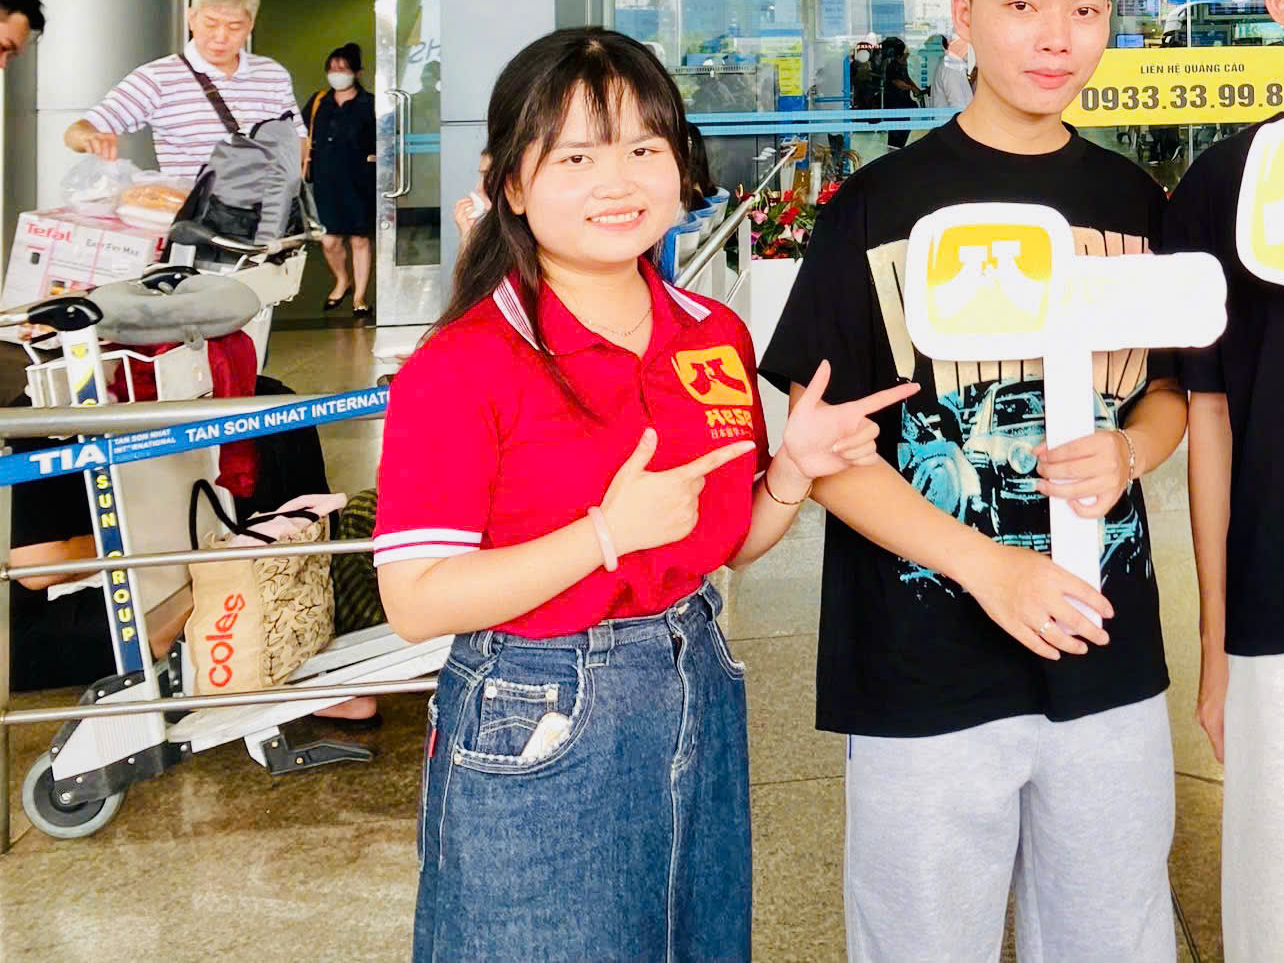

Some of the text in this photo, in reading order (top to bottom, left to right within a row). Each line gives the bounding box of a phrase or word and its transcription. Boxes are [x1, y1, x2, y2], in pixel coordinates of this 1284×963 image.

[26, 222, 72, 243] Tefal
[185, 424, 220, 442] TAN
[224, 417, 260, 436] SON
[264, 407, 307, 427] NHAT
[29, 442, 108, 475] TIA
[96, 474, 116, 527] SUN
[205, 593, 246, 687] coles
